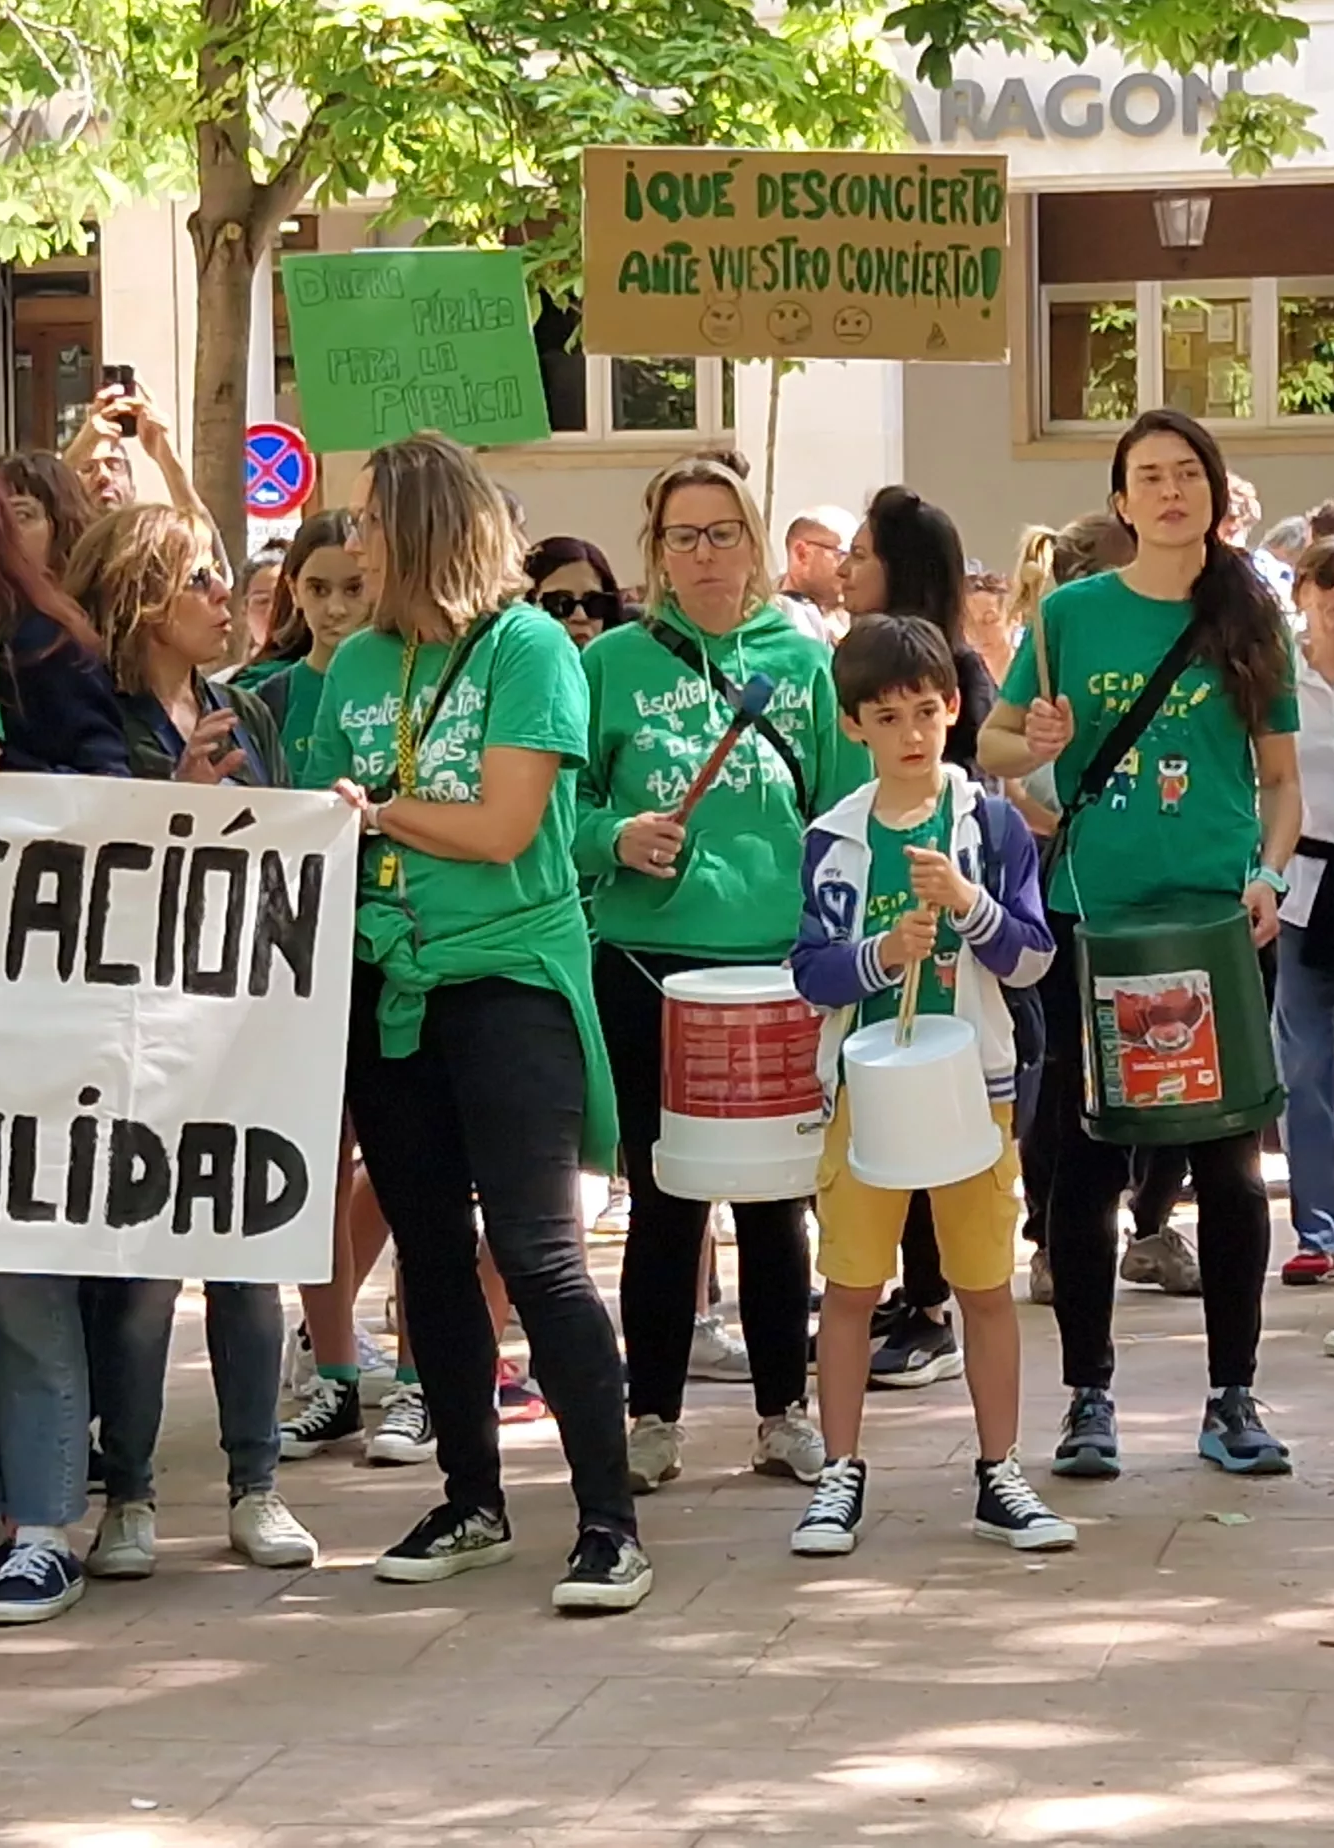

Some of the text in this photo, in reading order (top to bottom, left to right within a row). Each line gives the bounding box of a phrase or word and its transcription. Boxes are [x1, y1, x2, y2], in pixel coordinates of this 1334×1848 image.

[623, 158, 744, 224] ¡QUÉ
[617, 240, 702, 296] ANTE
[708, 236, 832, 294] VUESTRO
[419, 341, 458, 376] LA
[339, 691, 423, 731] ESCUEA
[354, 751, 385, 777] DE
